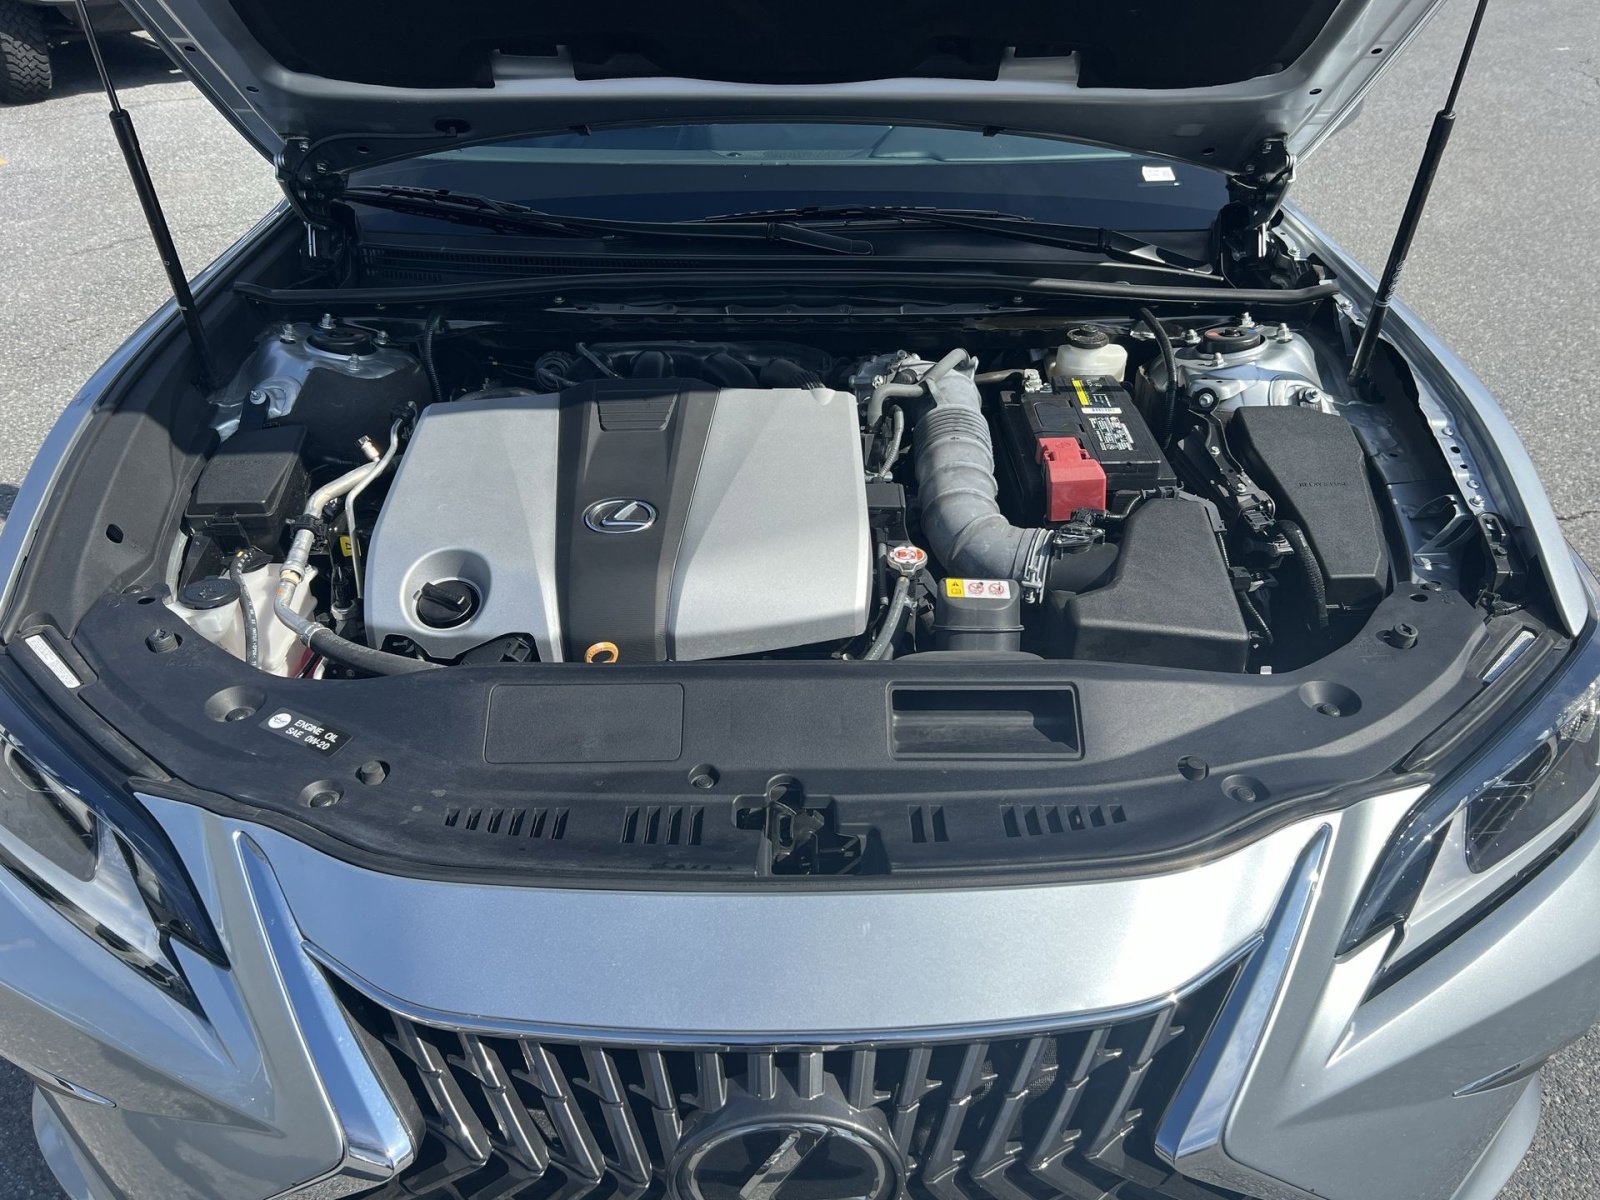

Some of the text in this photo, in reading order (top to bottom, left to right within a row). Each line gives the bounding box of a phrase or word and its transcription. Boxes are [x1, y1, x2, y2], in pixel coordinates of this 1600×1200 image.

[285, 727, 331, 750] SAE 0W-20
[294, 719, 339, 743] ENGINE OIL
